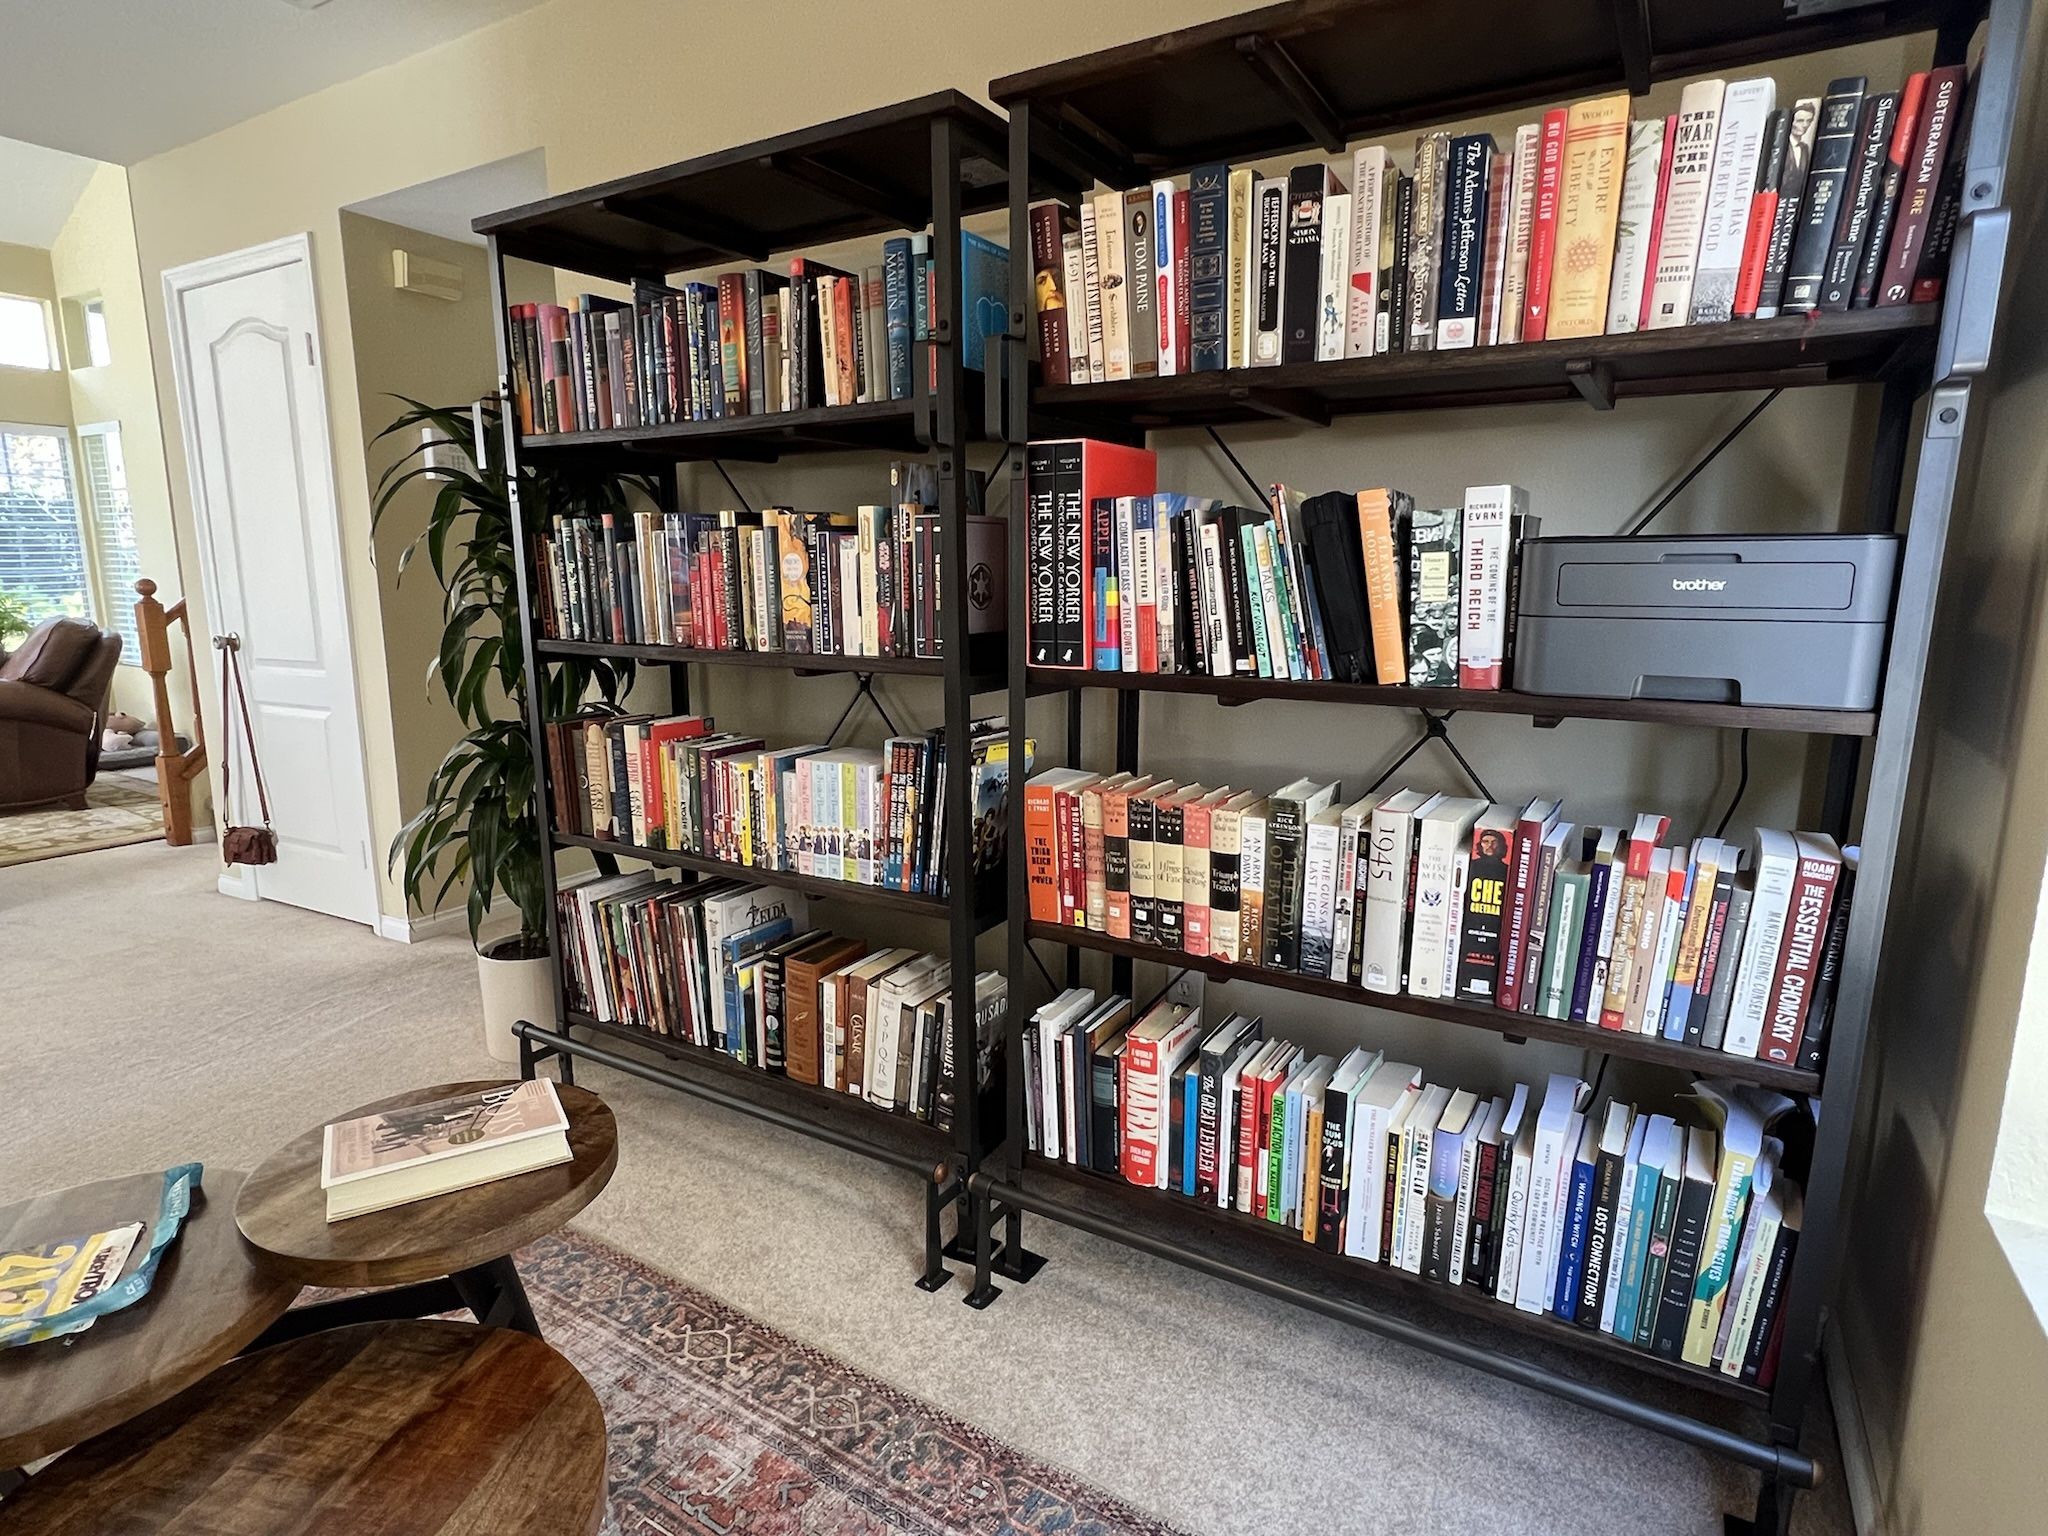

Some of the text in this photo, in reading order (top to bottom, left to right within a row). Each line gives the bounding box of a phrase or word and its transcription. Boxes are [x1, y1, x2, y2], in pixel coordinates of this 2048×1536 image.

[1680, 124, 1713, 143] WAR
[1683, 111, 1715, 121] THE
[1421, 143, 1432, 181] STEPHEN
[1540, 122, 1559, 220] NO GOD BUT GAIN
[1674, 165, 1707, 174] WAR
[1677, 154, 1708, 162] THE
[1848, 98, 1892, 242] Slavery by Another Name
[1910, 80, 1954, 215] SUBTERRANEAN FIRE
[1517, 134, 1538, 254] AMERICAN UPRISING
[1565, 151, 1585, 227] LIBERTY
[1595, 147, 1614, 213] EMPIRE
[1705, 121, 1739, 251] NEVER BEEN TOLD
[1728, 132, 1757, 235] THE HALF HAS
[1263, 229, 1270, 240] OF
[1270, 197, 1279, 245] JEFFERSON
[1419, 192, 1429, 233] AMBROSE
[1455, 142, 1481, 312] The Adams-Jefferson Letters
[1775, 197, 1799, 273] LINCOLN'S
[887, 253, 898, 310] MARTIN
[916, 267, 925, 312] PAULA
[1069, 255, 1079, 283] 1491
[1082, 217, 1102, 344] FARMERS & FISHERMEN
[1134, 238, 1148, 313] TOM PAINE
[724, 344, 740, 403] DUNE
[1097, 508, 1110, 555] APPLE
[1469, 512, 1503, 520] EVANS
[1031, 562, 1037, 574] OF
[1038, 491, 1053, 623] THE NEW YORKER
[1057, 563, 1064, 574] OF
[1066, 489, 1080, 624] THE NEW YORKER
[1120, 522, 1130, 591] COMPLACENT CLASS
[1365, 530, 1382, 610] ROOSEVELT
[1378, 536, 1393, 601] ELEANOR
[1490, 547, 1498, 560] THE
[1261, 568, 1274, 603] TALKS
[1468, 539, 1483, 630] THIRD REICH
[1488, 565, 1497, 592] COMING
[1672, 578, 1727, 591] brother
[1123, 608, 1133, 656] TYLER COWEN
[1250, 591, 1266, 657] KURT VONNEGUT
[1487, 609, 1496, 622] THE
[890, 785, 898, 801] LONG
[896, 804, 904, 838] HALLOWEEN
[1034, 838, 1047, 846] THE
[1071, 807, 1080, 846] ORDINARY
[1031, 847, 1050, 856] THIRD
[1032, 857, 1050, 865] REICH
[1212, 868, 1239, 881] Triumph
[1242, 837, 1251, 883] AT DAWN
[1252, 838, 1261, 887] AN ARMY
[1370, 827, 1395, 882] 1945
[1517, 837, 1531, 888] JON MEACHAM
[1803, 861, 1834, 873] NOAM
[1032, 876, 1052, 885] POWER
[1212, 882, 1239, 893] Tragedy
[1266, 845, 1282, 947] OF BATTLE
[1280, 859, 1296, 940] THE DAY
[1307, 861, 1318, 926] LAST LIGHT
[1320, 859, 1331, 930] THE GUNS AT
[1471, 878, 1504, 905] CHE
[1516, 893, 1525, 905] HIS
[1803, 884, 1826, 899] THE
[1242, 893, 1250, 943] ATKINSON
[1513, 907, 1523, 929] TRUTH
[1640, 910, 1654, 949] ADORNO
[1505, 939, 1518, 974] MARCHING
[1747, 911, 1782, 1021] MANUFACTURING CONSENT
[1772, 899, 1821, 1042] ESSENTIAL CHOMSKY
[1504, 976, 1514, 986] ON
[851, 1014, 864, 1053] CAESAR
[481, 1089, 526, 1135] BOYS
[1127, 1070, 1158, 1144] MARX
[1200, 1075, 1216, 1173] The GREAT LEVELER
[1240, 1085, 1254, 1157] BEGIN AGAIN
[1327, 1121, 1341, 1132] THE
[1413, 1141, 1428, 1195] COLOR LAW
[1721, 1160, 1746, 1220] TRANS BODIES
[1506, 1190, 1523, 1248] Quirky Kids
[1583, 1207, 1608, 1306] LOST CONNECTIONS
[1708, 1224, 1732, 1281] TRANS SELVES
